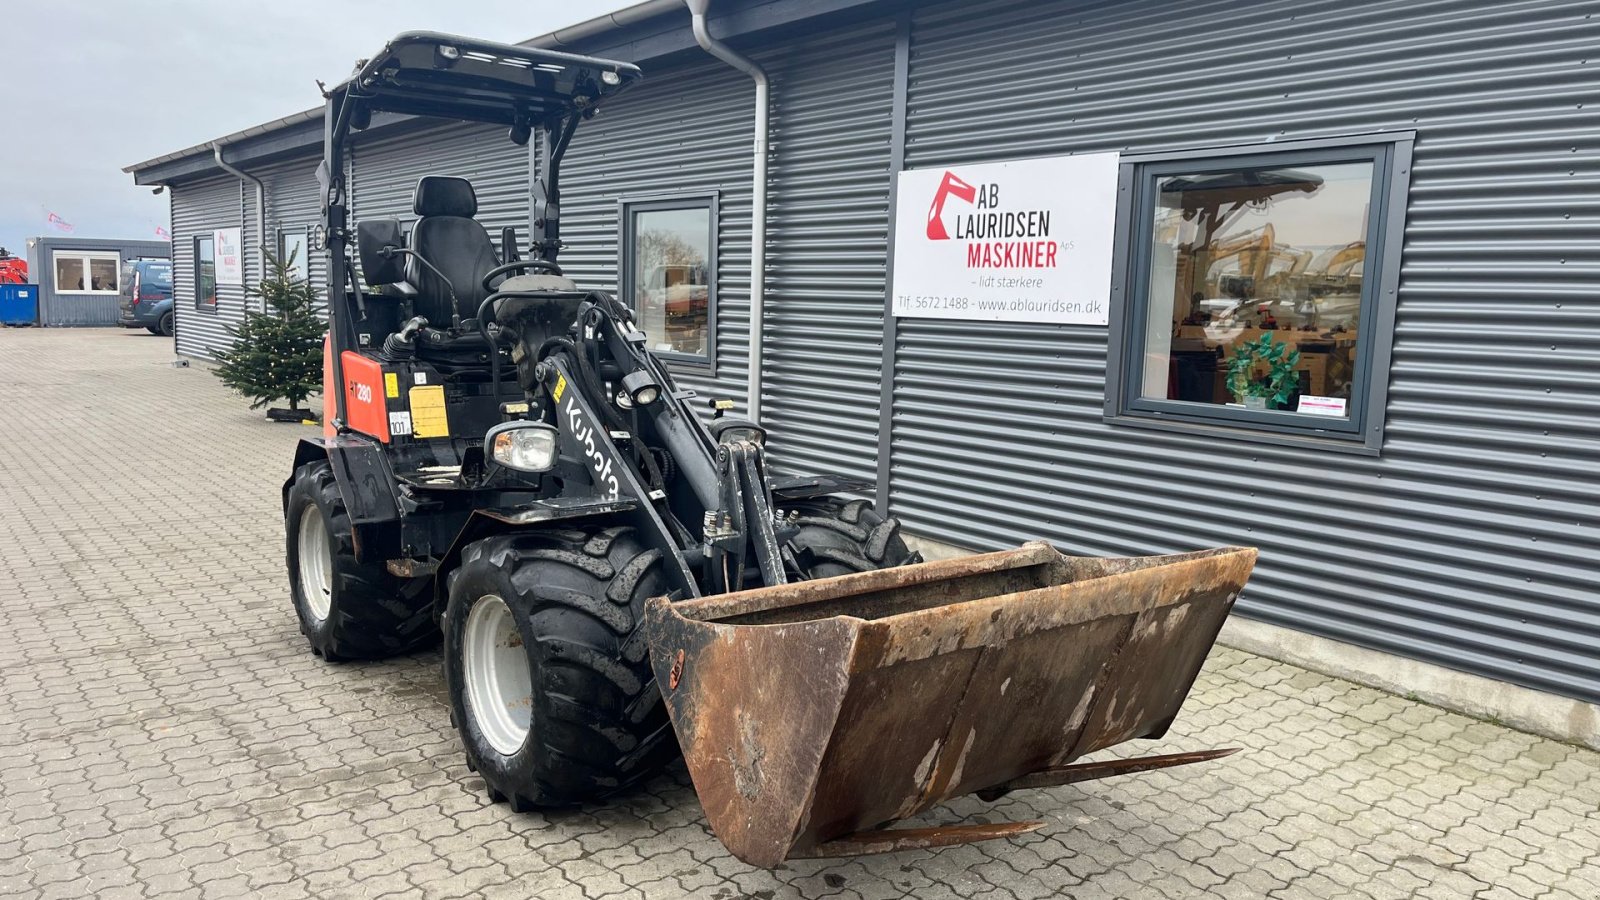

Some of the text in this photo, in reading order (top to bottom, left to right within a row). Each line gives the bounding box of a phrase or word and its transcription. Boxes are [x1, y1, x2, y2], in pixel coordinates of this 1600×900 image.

[977, 183, 999, 209] AB
[956, 210, 1051, 239] LAURIDSEN
[967, 241, 1058, 269] MASKINER
[979, 276, 995, 288] lidt
[997, 277, 1043, 289] stærkere
[898, 295, 913, 310] Tlf.
[916, 296, 940, 310] 5672
[943, 297, 968, 310] 1488
[978, 298, 1102, 315] www.ablauridsen.dk
[391, 421, 405, 434] 101
[565, 396, 619, 496] Kubota
